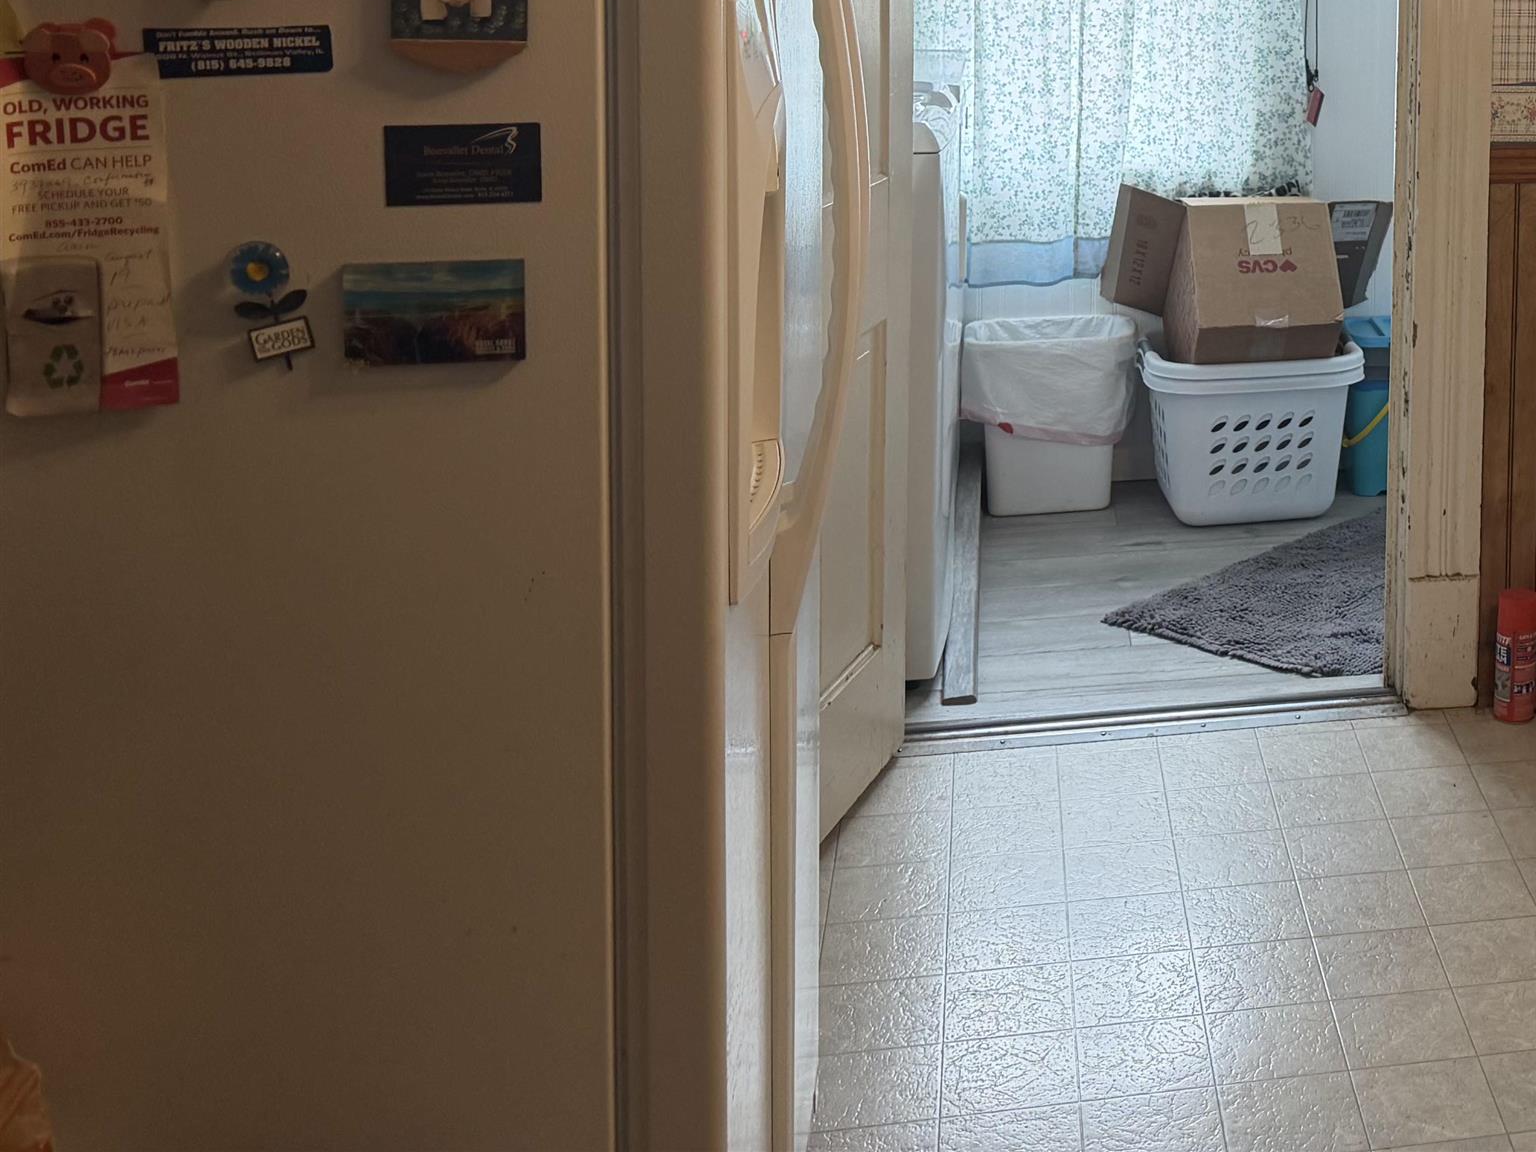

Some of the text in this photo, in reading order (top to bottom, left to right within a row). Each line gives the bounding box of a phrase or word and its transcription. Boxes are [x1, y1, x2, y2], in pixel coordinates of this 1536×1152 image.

[158, 36, 320, 53] FRITZ'S WOODEN NICKEL
[3, 94, 149, 115] OLD, WORKING
[6, 114, 150, 149] FRIDGE
[10, 154, 153, 174] ComEd CAN HELP
[38, 187, 129, 200] SCHEDULE YOUR
[12, 203, 38, 215] FREE
[40, 201, 81, 212] PICKUP
[83, 199, 108, 209] AND
[110, 198, 132, 208] GET
[8, 226, 160, 242] ComEd.com/FridgeRecycling
[1238, 259, 1278, 274] CVS
[255, 326, 306, 346] GARDEN
[271, 337, 308, 350] GODS
